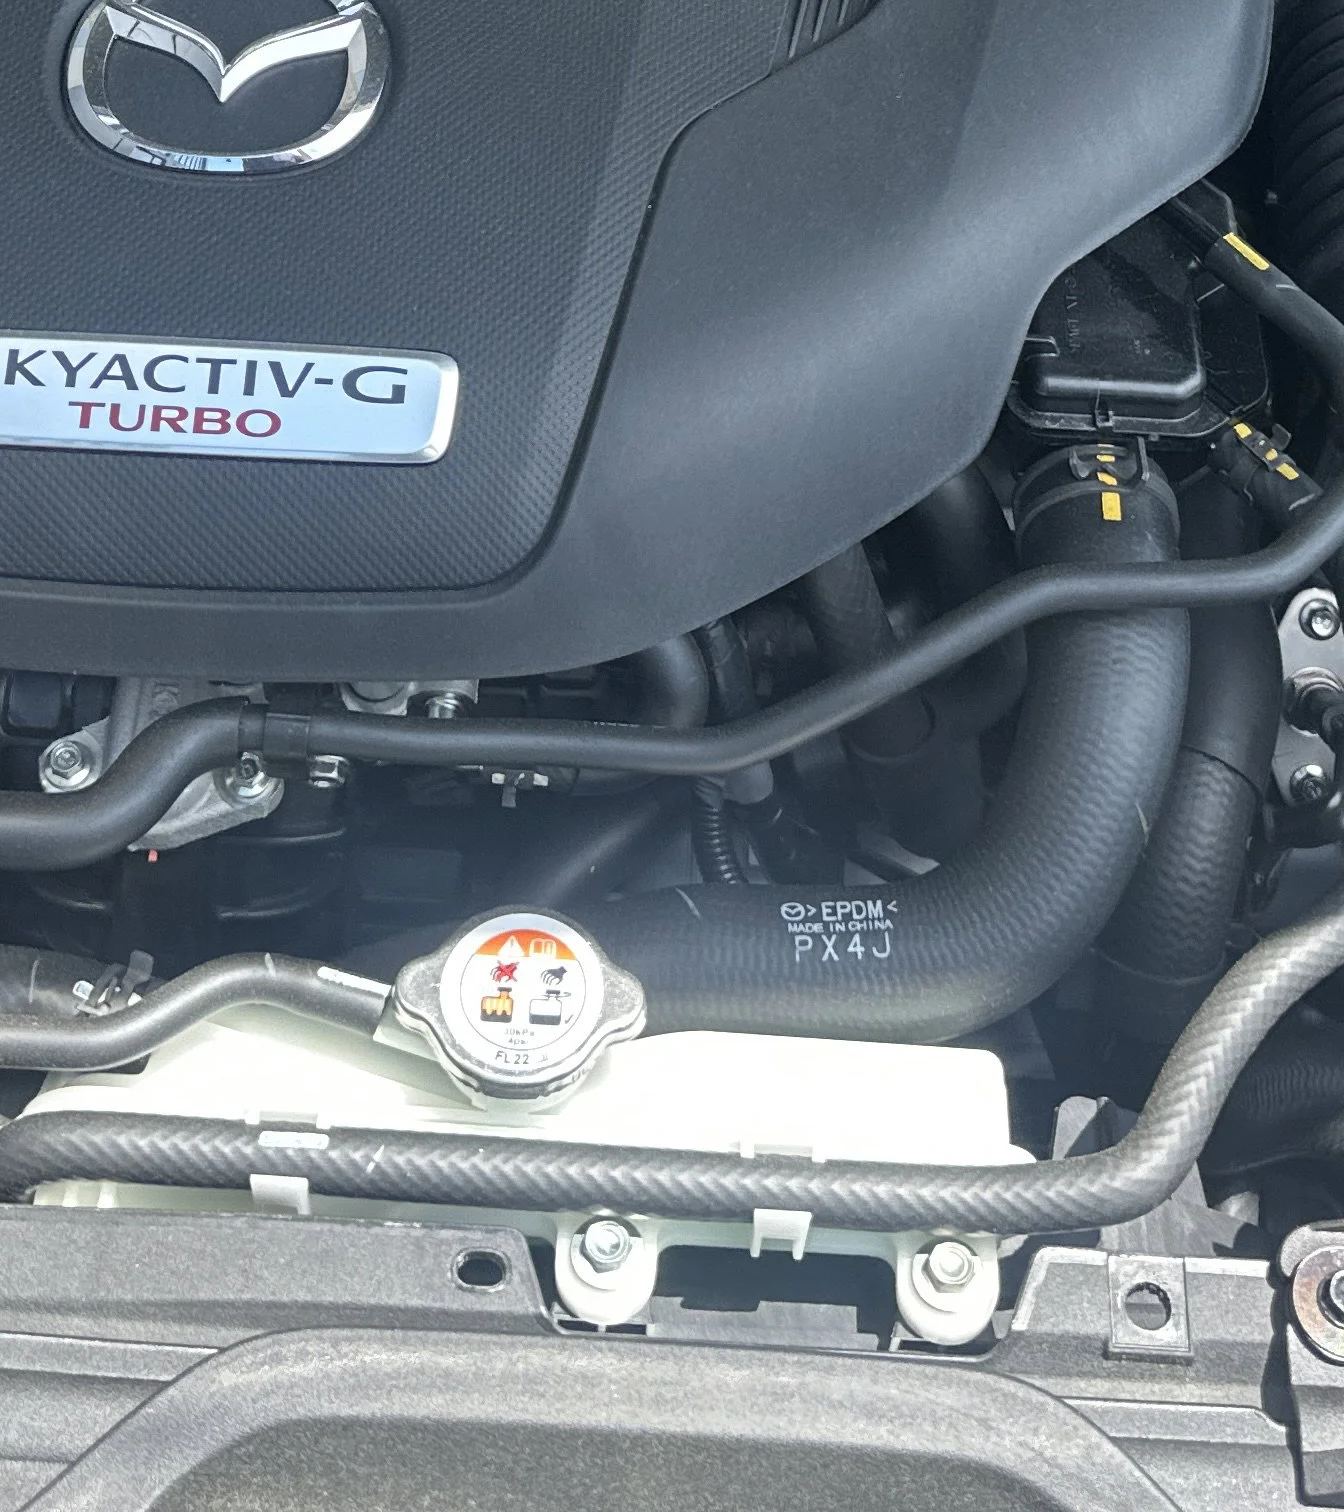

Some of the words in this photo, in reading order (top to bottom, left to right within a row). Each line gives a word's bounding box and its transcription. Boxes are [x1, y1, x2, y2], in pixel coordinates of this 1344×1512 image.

[67, 400, 282, 438] TURBO
[788, 922, 824, 933] MADE
[829, 921, 846, 933] IN
[848, 919, 894, 931] CHINA
[495, 1050, 530, 1065] FL22
